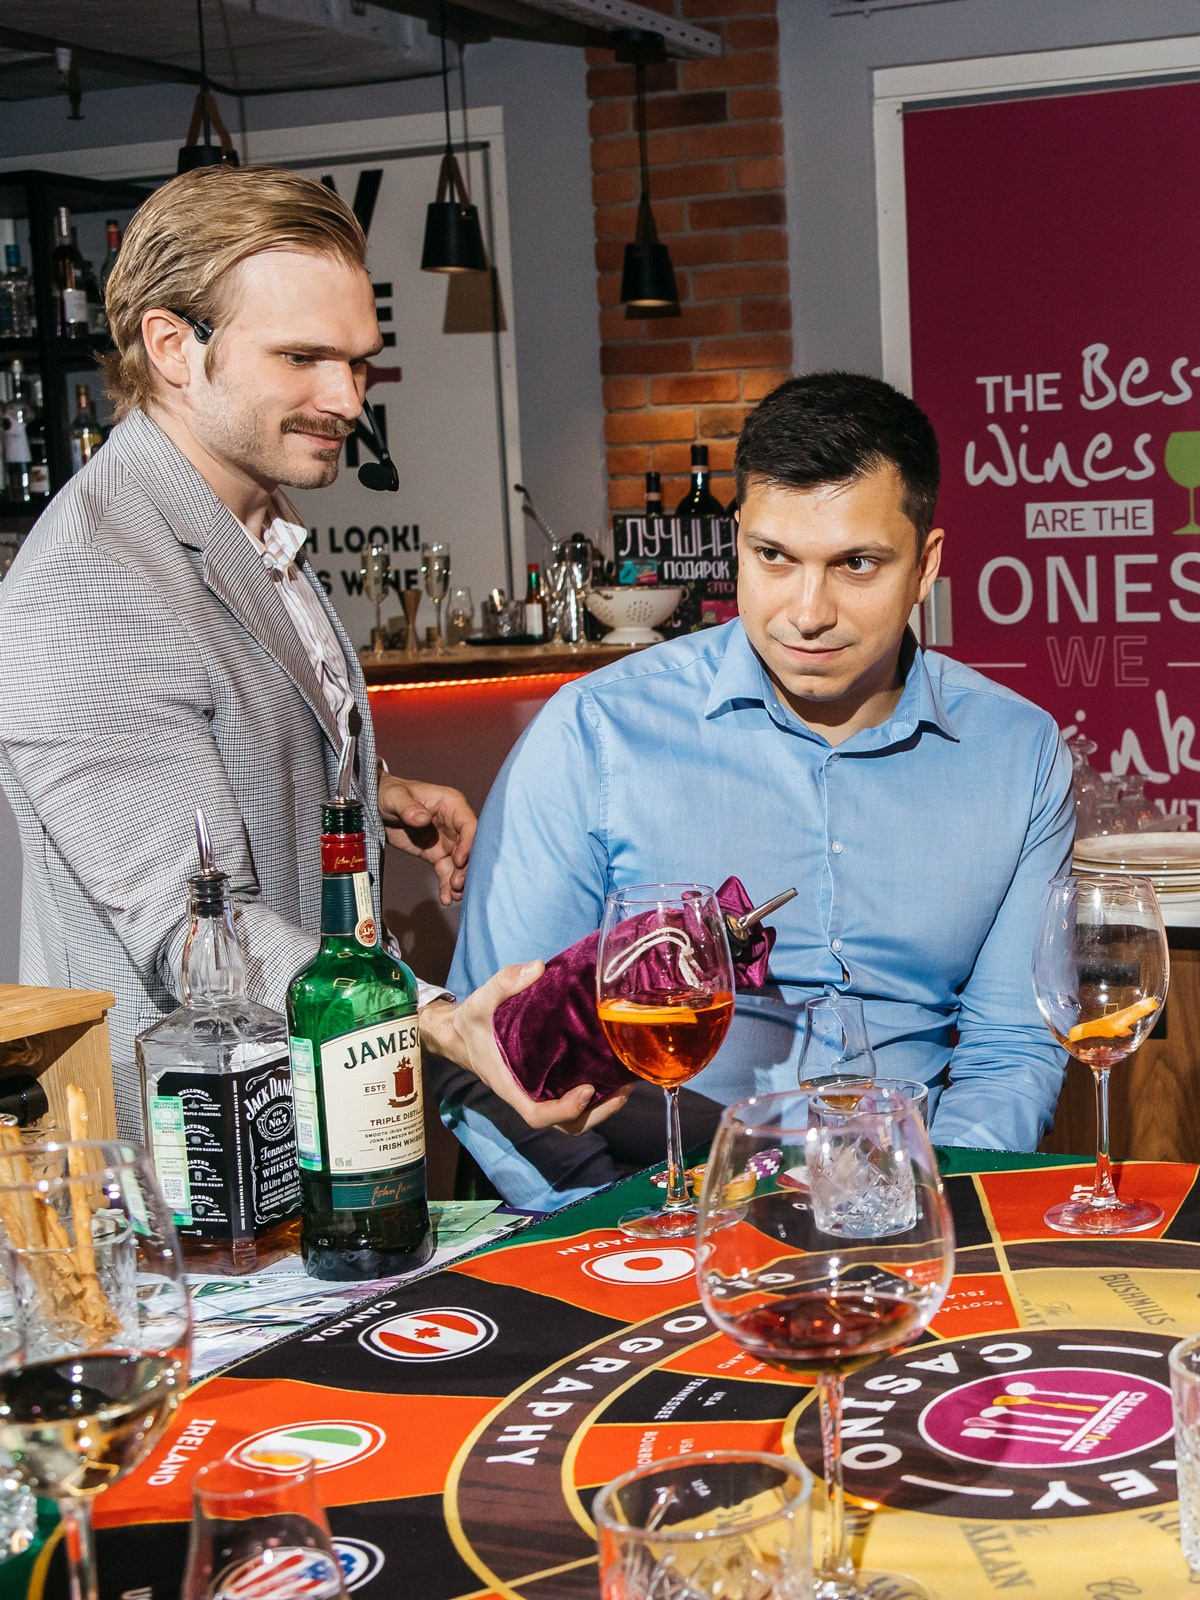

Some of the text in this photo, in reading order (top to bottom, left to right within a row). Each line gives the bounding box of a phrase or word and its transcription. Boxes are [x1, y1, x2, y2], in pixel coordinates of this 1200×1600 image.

[975, 372, 1063, 414] THE
[964, 424, 1157, 488] Wines
[1031, 506, 1148, 534] ARE THE
[329, 524, 420, 554] LOOK!
[619, 517, 737, 557] ЛУЧШИЙ
[663, 560, 730, 581] ПОДАРОК
[1046, 635, 1150, 688] WE
[343, 1026, 420, 1069] JAMES
[243, 1088, 270, 1121] JACK
[269, 1077, 293, 1100] DANI
[272, 1109, 283, 1117] Old
[268, 1114, 288, 1130] No.7
[364, 1131, 389, 1139] SMOOTH
[370, 1115, 401, 1127] TRIPLE
[378, 1132, 424, 1152] IRISH WHISKE
[261, 1158, 298, 1178] WHISKEY
[557, 1238, 637, 1256] JAPAN
[936, 1300, 1003, 1314] SCOTLA
[944, 1289, 985, 1300] ISLA
[1099, 1272, 1176, 1326] BUSHMILLS
[301, 1300, 398, 1343] CANADA
[653, 1378, 709, 1420] TENNESSEE
[702, 1391, 727, 1407] USA
[841, 1342, 1033, 1471] CASINO
[146, 1418, 218, 1487] IRELAND
[637, 1431, 658, 1468] BOURBO
[679, 1438, 695, 1454] USA
